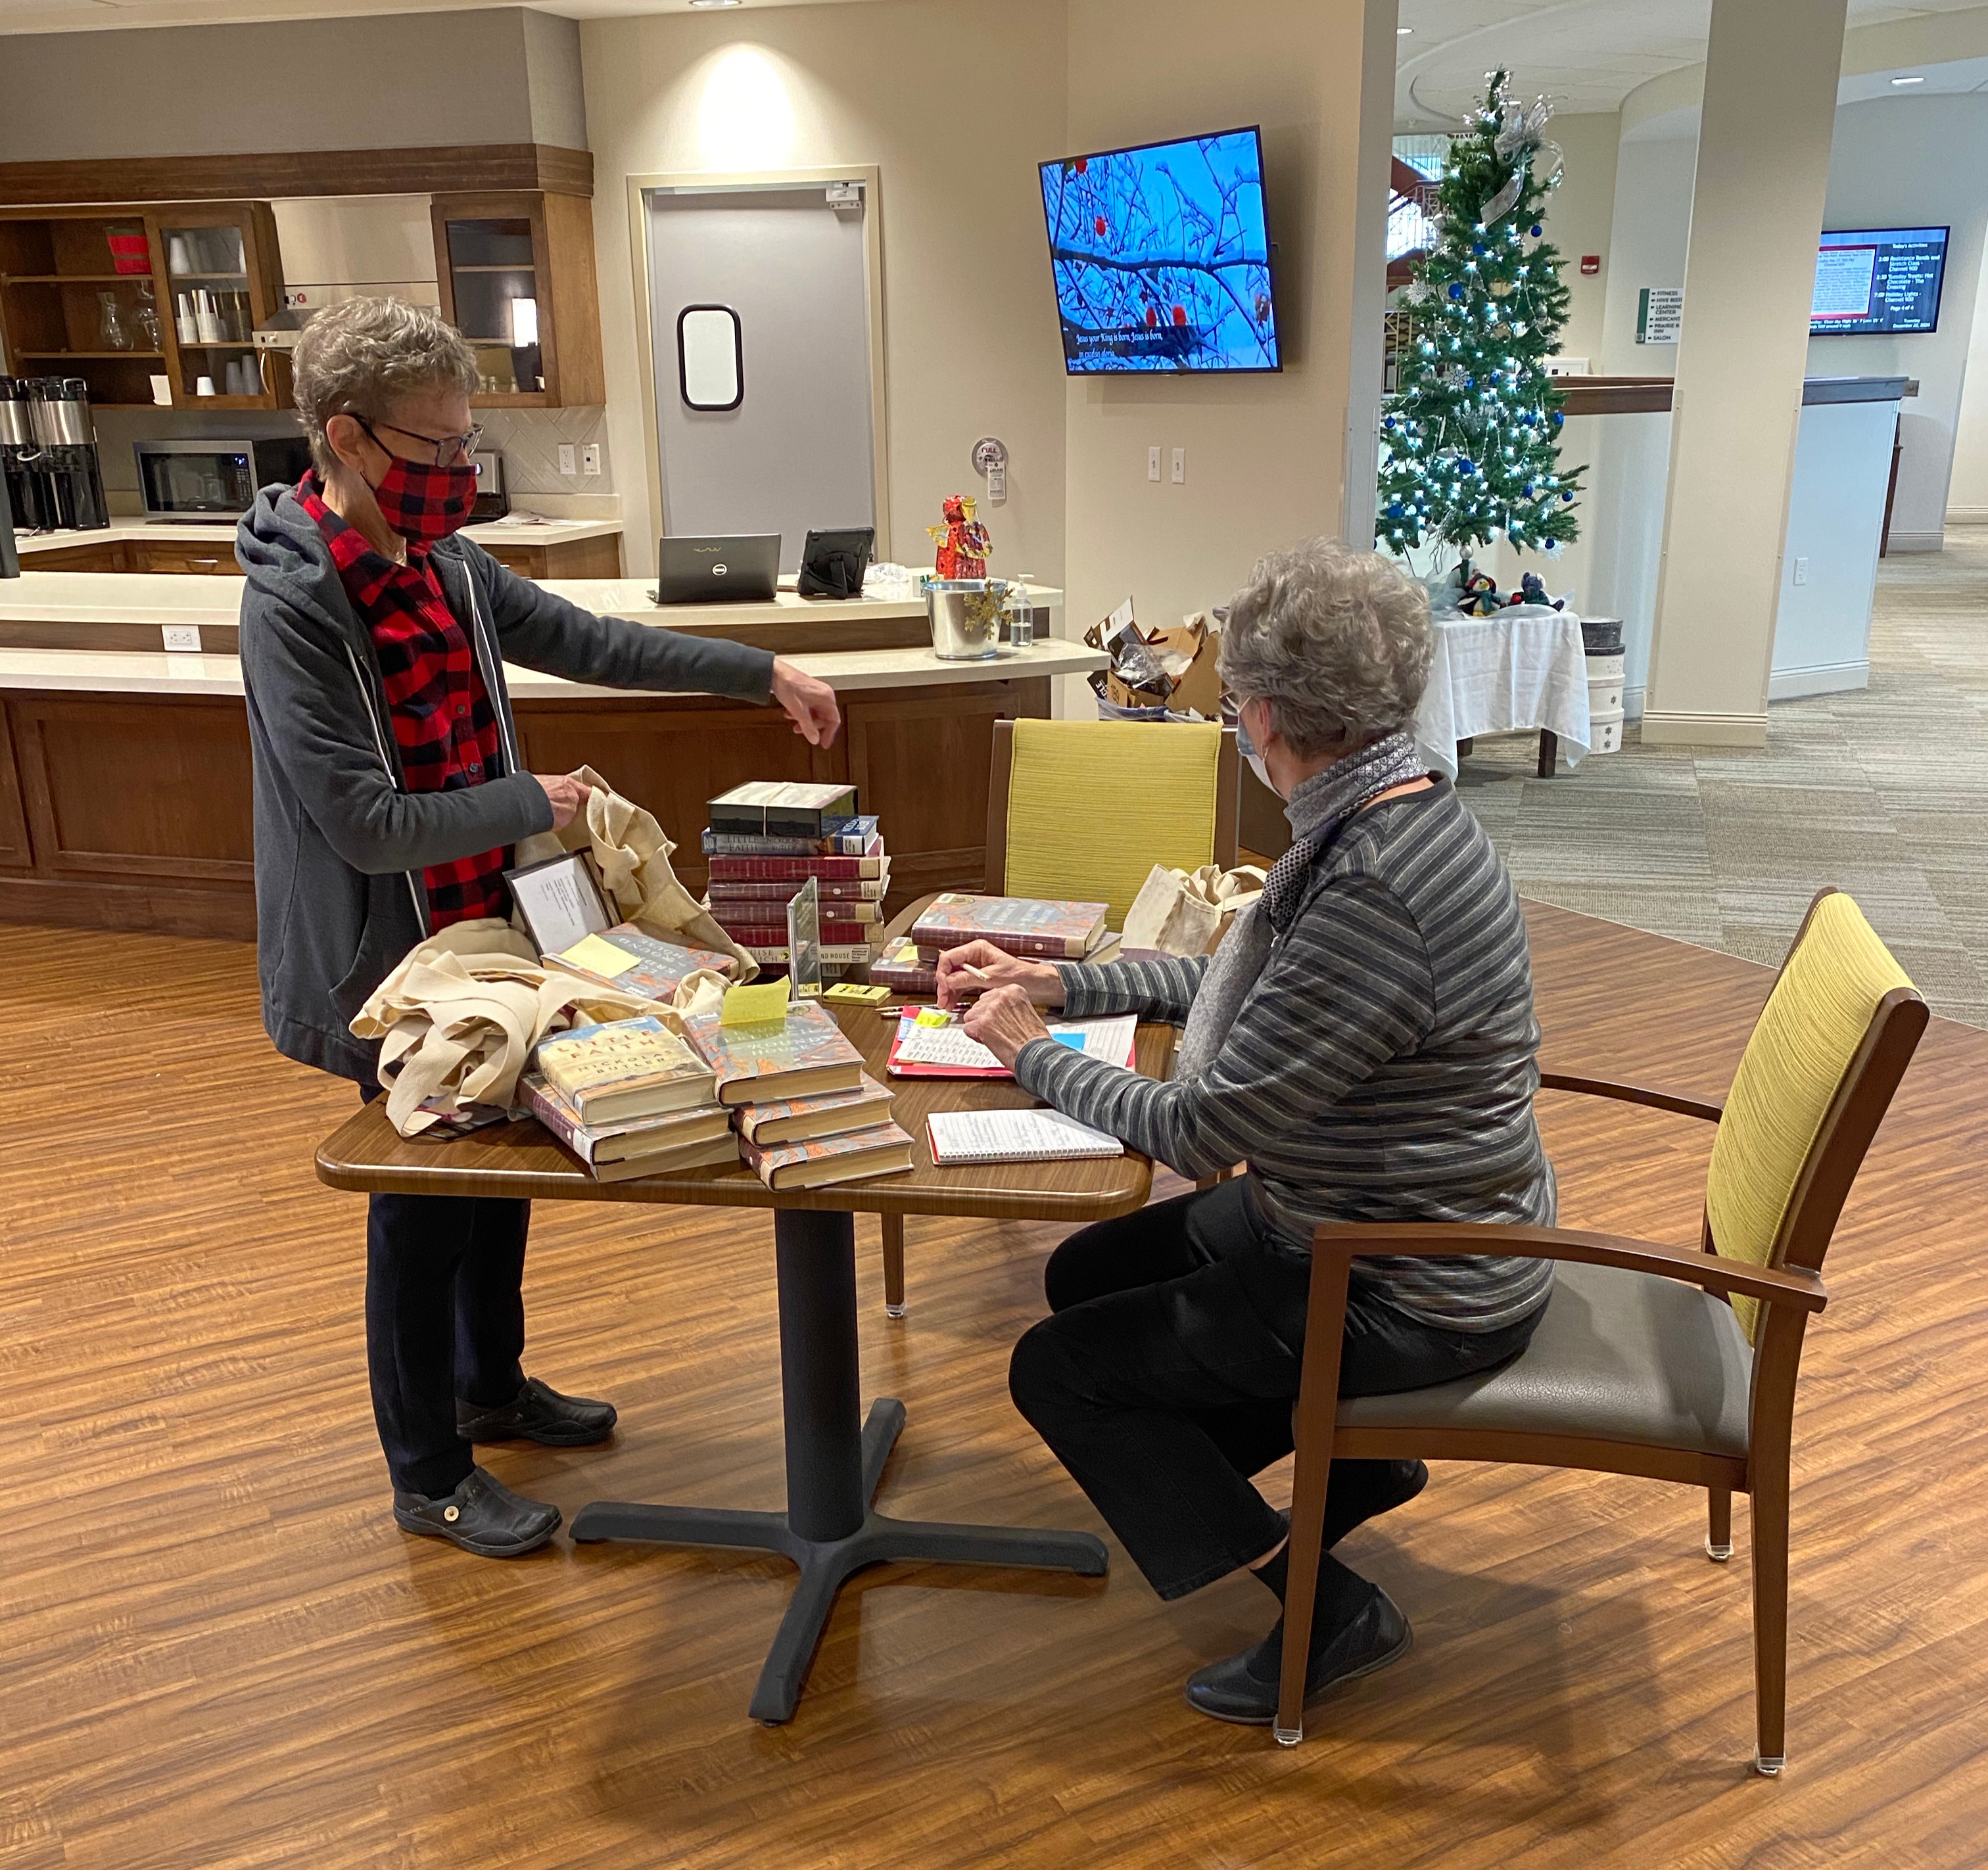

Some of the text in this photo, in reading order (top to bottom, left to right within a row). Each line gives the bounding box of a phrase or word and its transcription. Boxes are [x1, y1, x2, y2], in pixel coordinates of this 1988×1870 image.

[1076, 334, 1089, 344] Jesus
[1100, 333, 1113, 345] King
[1114, 333, 1118, 341] is
[1131, 331, 1144, 342] Jesus
[1145, 331, 1149, 340] is
[1095, 680, 1108, 698] CLE
[729, 843, 757, 852] FAITH
[619, 938, 674, 962] ROUND
[639, 939, 686, 959] HOUSE
[642, 956, 676, 974] ERD
[557, 1029, 653, 1053] LITTLE
[570, 1039, 655, 1059] FAITH
[747, 1037, 821, 1050] ROUND
[751, 1044, 810, 1056] HOUSE
[578, 1050, 673, 1073] NICKOLAS
[596, 1057, 665, 1073] BUTLER
